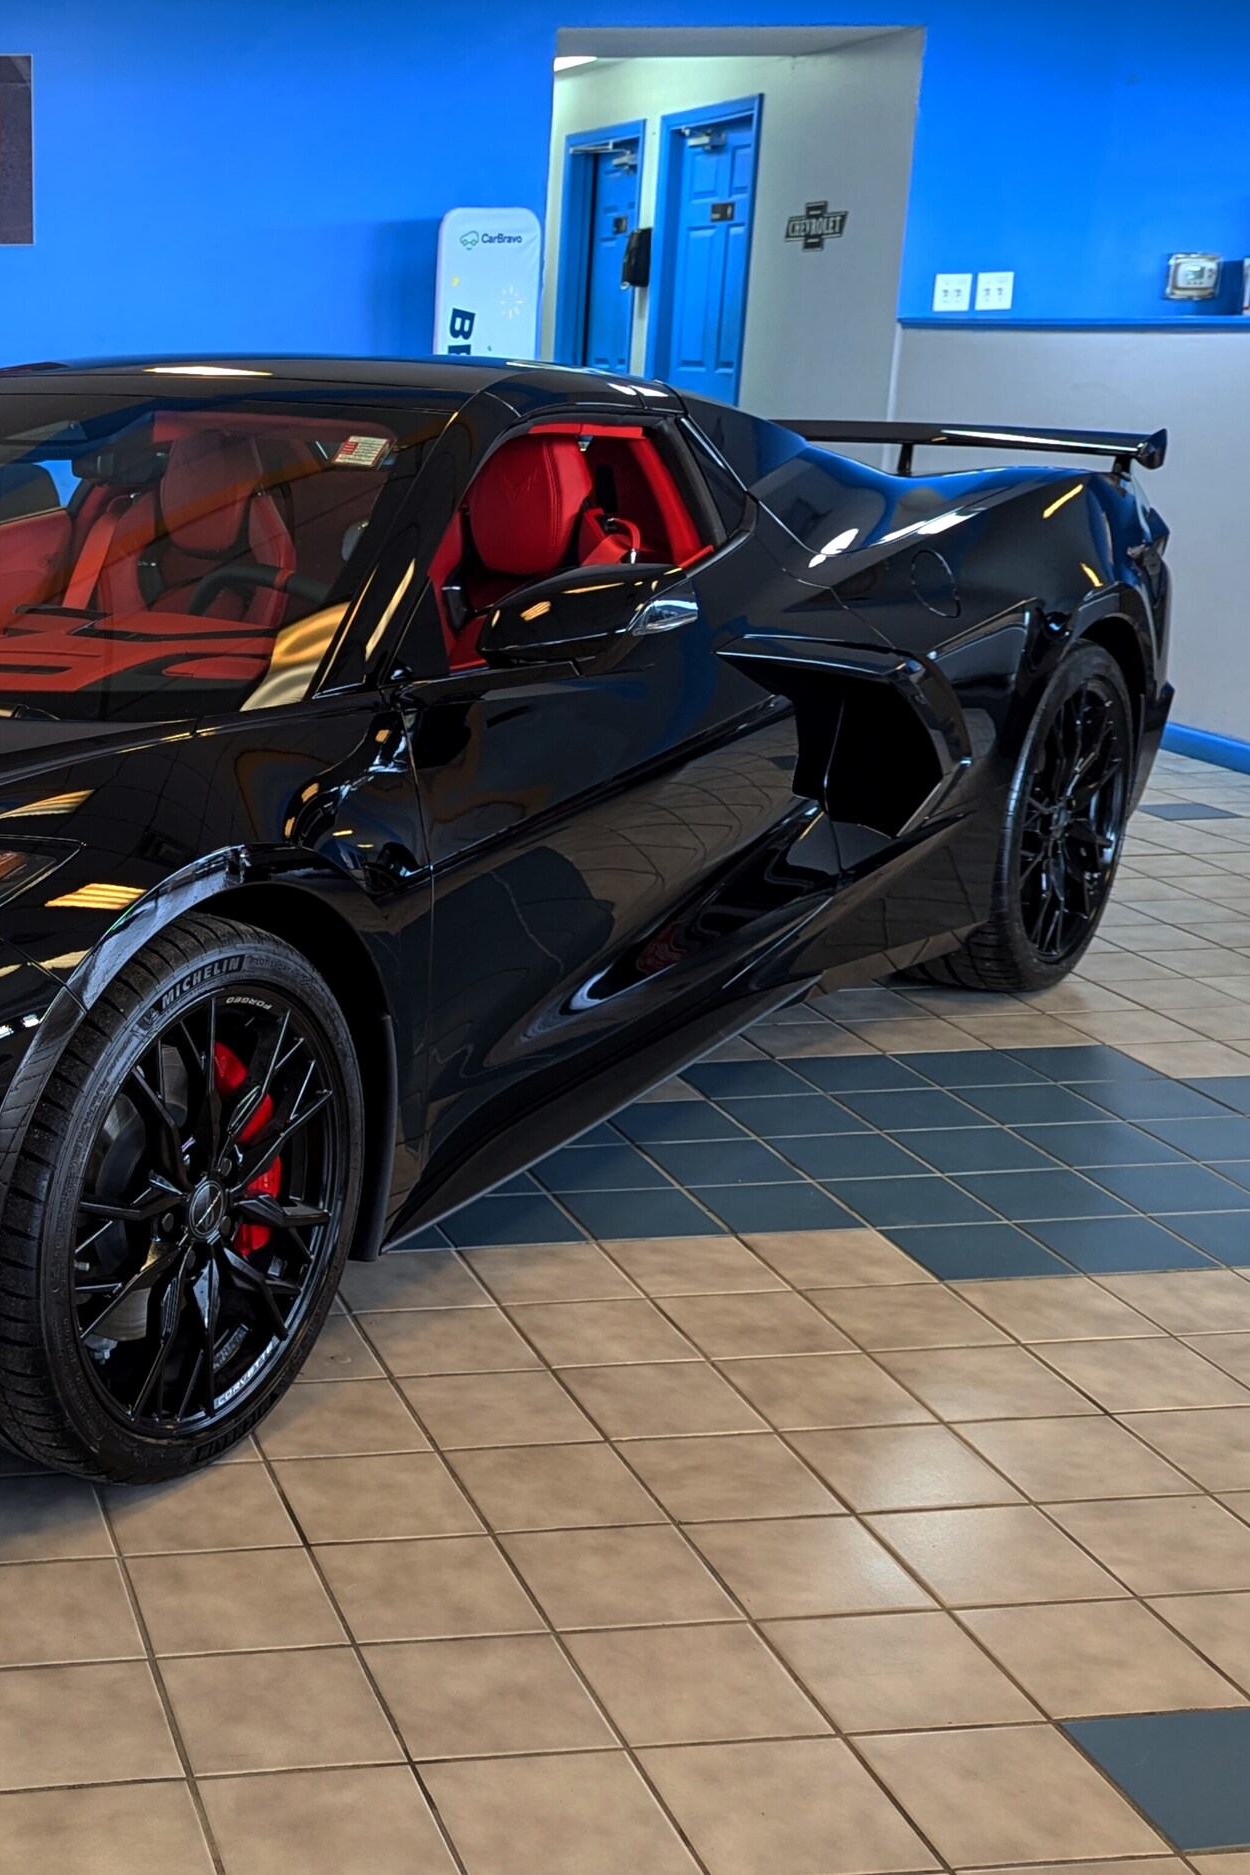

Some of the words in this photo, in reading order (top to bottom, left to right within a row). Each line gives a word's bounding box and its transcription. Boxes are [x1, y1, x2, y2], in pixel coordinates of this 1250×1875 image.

[788, 216, 842, 236] CHEVROLET
[481, 233, 523, 244] CarBravo
[161, 955, 241, 1010] MICHELIN
[225, 996, 272, 1010] FORGED
[217, 1341, 274, 1406] CORVETTE
